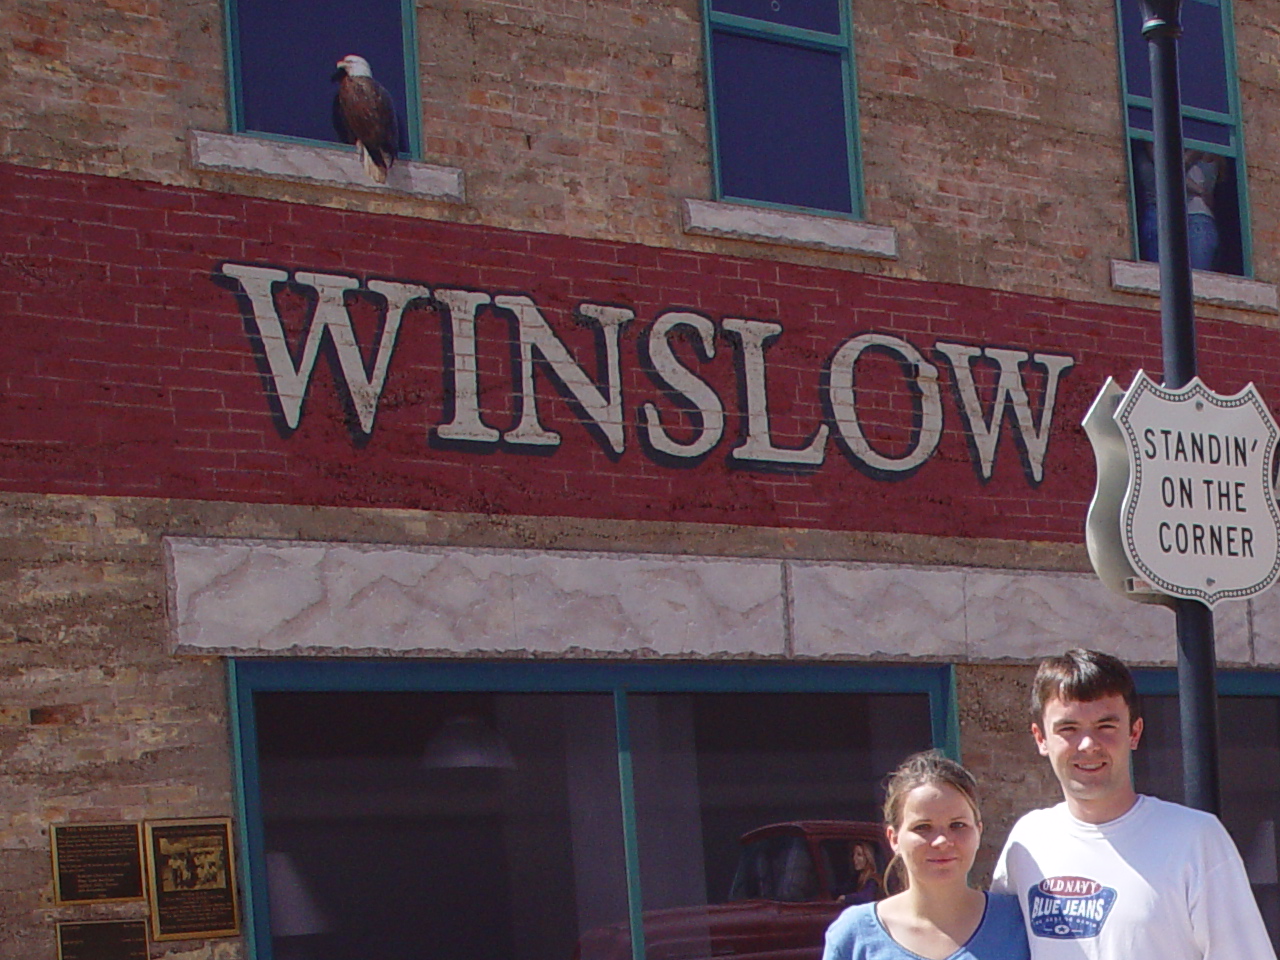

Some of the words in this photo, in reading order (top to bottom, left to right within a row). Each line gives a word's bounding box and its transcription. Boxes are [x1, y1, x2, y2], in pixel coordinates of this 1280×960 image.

[219, 262, 1075, 484] WINSLOW
[1144, 428, 1258, 467] STANDIN'
[1161, 476, 1193, 508] ON
[1203, 480, 1247, 512] THE
[1159, 522, 1254, 557] CORNER
[1042, 878, 1064, 892] OLD
[1065, 880, 1098, 895] NAVY
[1032, 896, 1062, 919] BLUE
[1063, 899, 1105, 921] JEANS
